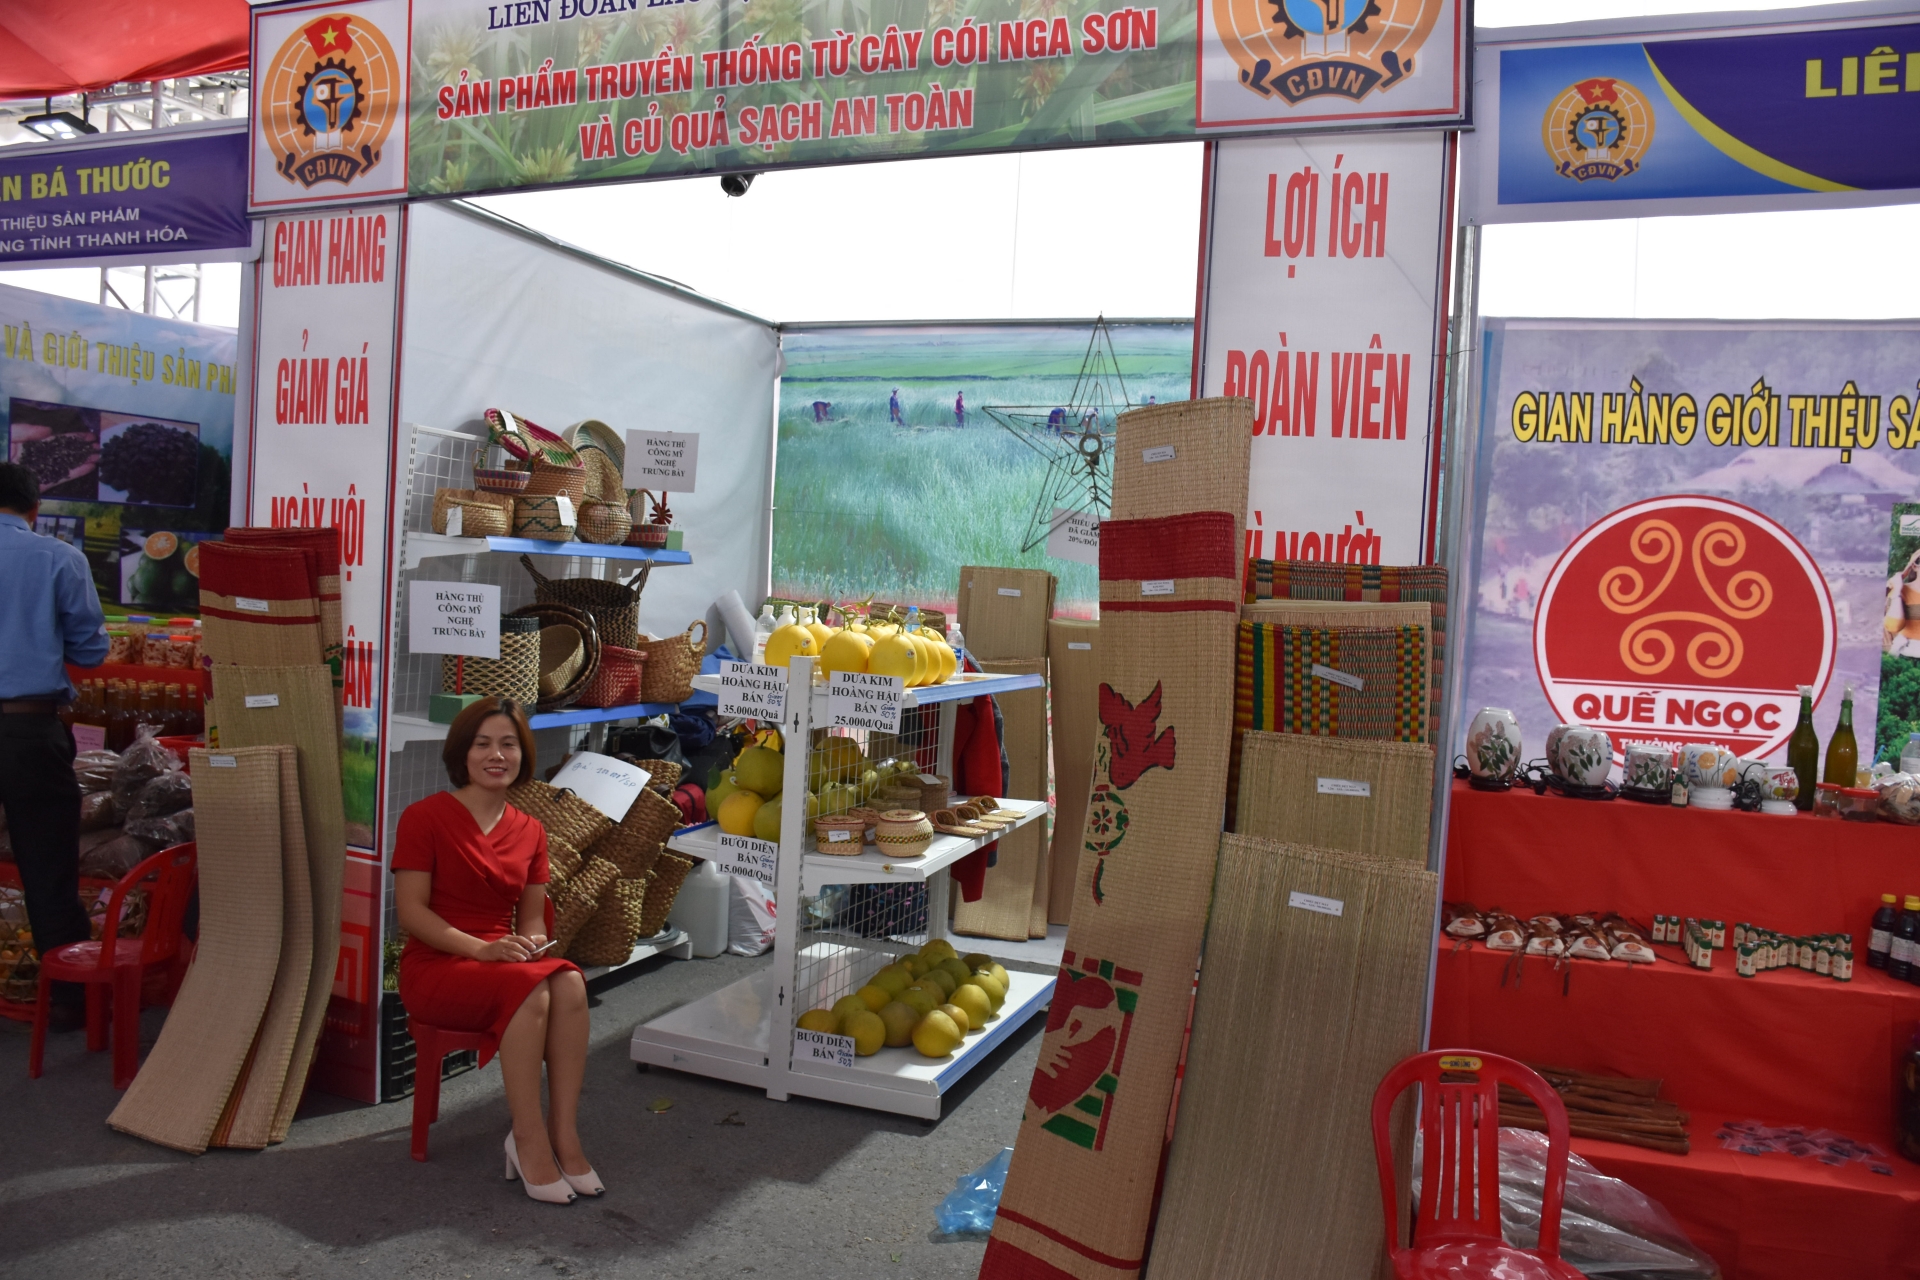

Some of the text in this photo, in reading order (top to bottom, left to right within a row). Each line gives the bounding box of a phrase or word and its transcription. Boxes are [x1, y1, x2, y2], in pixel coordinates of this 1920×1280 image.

[438, 6, 1158, 120] SẢN PHẨM TRUYỀN THỐNG TỪ CÂY CÓI NGA SƠN
[1286, 67, 1366, 97] CĐVN
[579, 82, 975, 161] VÀ CỦ QUẢ SẠCH AN TOÀN
[304, 158, 351, 182] CĐVN
[1578, 164, 1617, 178] CĐVN
[0, 157, 170, 201] N BÁ THƯỚC
[1, 206, 140, 231] THIỆU SẢN PHẨM
[1264, 154, 1389, 278] LỢI ÍCH
[30, 234, 71, 250] TỈNH
[77, 231, 140, 248] THANH
[147, 225, 188, 242] HÓA
[273, 209, 386, 288] GIAN HÀNG
[4, 321, 34, 362] VÀ
[43, 330, 88, 370] GIỚI
[97, 342, 155, 386] THIỆU
[161, 348, 200, 390] SẢN
[275, 329, 369, 425] GIẢM GIÁ
[1224, 332, 1411, 440] ĐOÀN VIÊN
[1512, 390, 1594, 443] GIAN
[1601, 375, 1698, 446] HÀNG
[1705, 375, 1781, 447] GIỚI
[1788, 380, 1881, 464] THIỆU
[646, 438, 686, 448] HÀNG THỦ
[647, 448, 671, 457] CÔNG
[655, 459, 676, 468] NGHỆ
[642, 467, 686, 477] TRƯNG BÀY
[330, 484, 365, 581] HỘI
[436, 591, 484, 603] HÀNG THỦ
[438, 603, 482, 614] CÔNG MỸ
[447, 616, 474, 627] NGHỆ
[432, 627, 486, 638] TRƯNG BÀY
[731, 663, 778, 677] DƯA KIM
[721, 676, 785, 693] HOÀNG HẬU
[842, 673, 893, 687] DƯA KIM
[742, 691, 764, 703] BÁN
[832, 686, 900, 703] HOÀNG HẬU
[723, 704, 778, 719] 35.000đ/Quả
[854, 701, 877, 714] BÁN
[1573, 691, 1782, 734] QUẾ NGỌC
[834, 715, 893, 731] 25.000đ/Quả
[721, 836, 748, 849] BƯỞI
[737, 852, 759, 864] BÁN
[719, 864, 773, 882] 15.000đ/Quả
[797, 1031, 824, 1044] BƯỞI
[812, 1047, 835, 1060] BÁN
